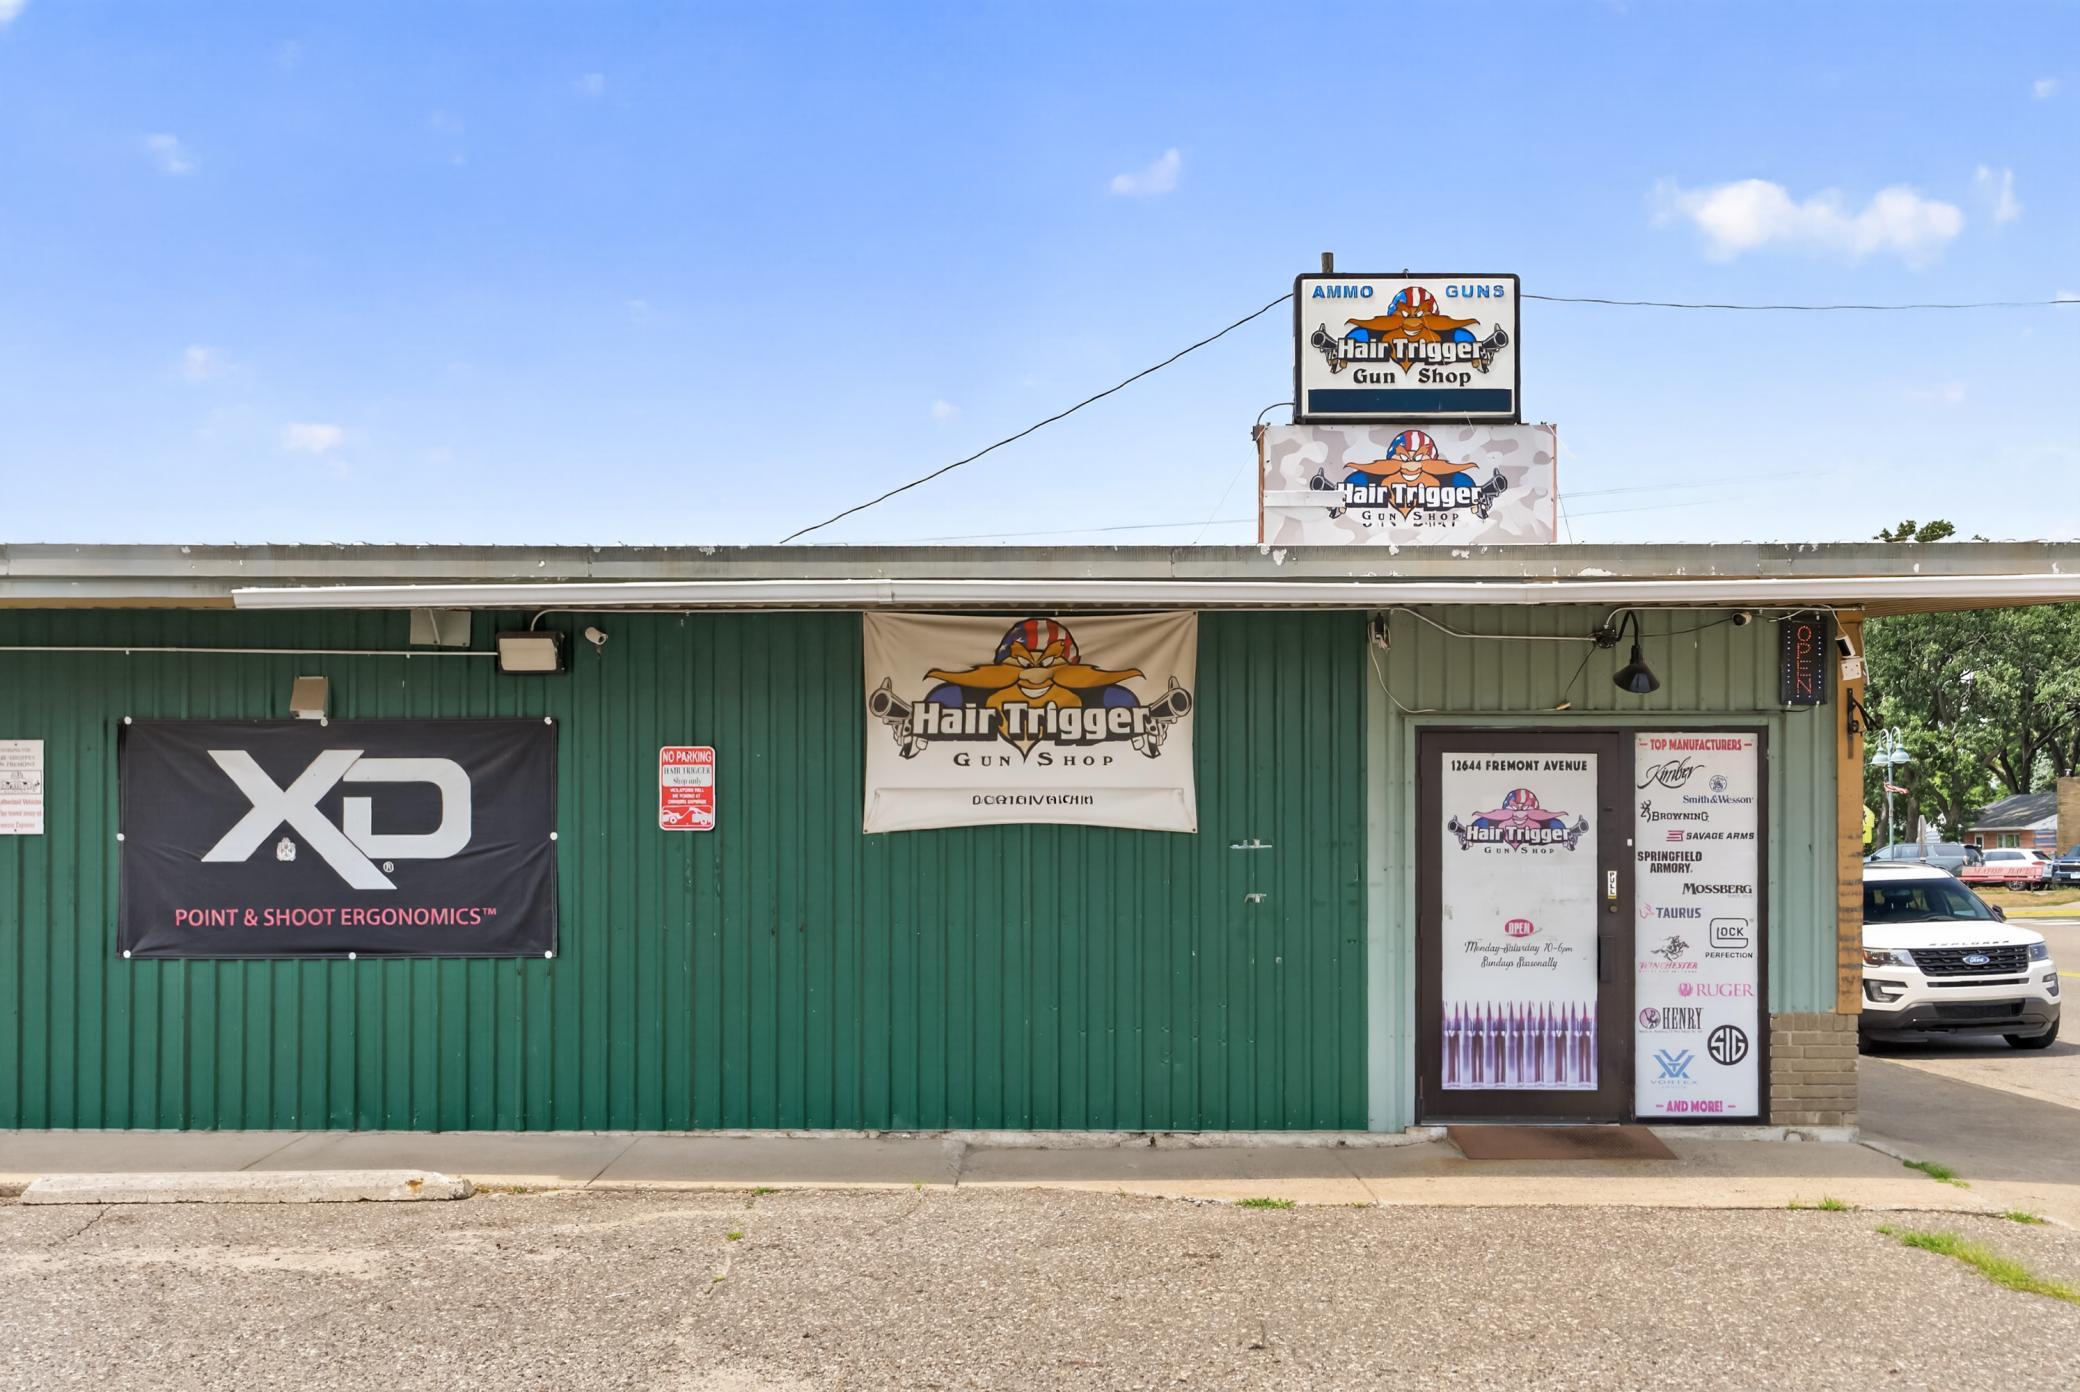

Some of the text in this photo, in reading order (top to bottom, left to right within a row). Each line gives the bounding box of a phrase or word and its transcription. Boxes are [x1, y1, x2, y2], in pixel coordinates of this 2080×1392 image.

[1312, 285, 1505, 299] AMMO GUNS
[1338, 338, 1483, 365] Hair Trigger
[1353, 368, 1472, 387] Gun Shop
[1337, 482, 1482, 508] Hair Trigger
[1362, 510, 1460, 521] GUN SHOP
[1796, 625, 1812, 697] OPEN
[912, 701, 1149, 740] Hair Trigger
[1650, 739, 1742, 750] TOP MANUFACTURERS
[663, 751, 712, 763] NO PARKING
[953, 752, 1114, 767] GUN SHOP
[1451, 760, 1587, 771] 12644 FREMONT AVENUE
[1637, 756, 1706, 789] Kimber
[1652, 811, 1709, 822] BROWNING
[1466, 826, 1570, 844] Hair Trigger
[1686, 832, 1755, 840] SAVAGE ARMS
[1637, 851, 1702, 862] SPRINGFIELD
[1650, 863, 1691, 873] ARMORY
[1682, 883, 1753, 895] MOSSBERG
[175, 908, 238, 927] POINT
[243, 908, 258, 927] &
[263, 908, 335, 927] SHOOT
[1656, 908, 1702, 919] TAURUS
[1508, 922, 1530, 934] OPEN
[1697, 983, 1754, 997] RUGER
[1662, 1007, 1703, 1029] HENRY
[1709, 1027, 1747, 1064] SIG
[1666, 1100, 1723, 1112] AND MORE!
